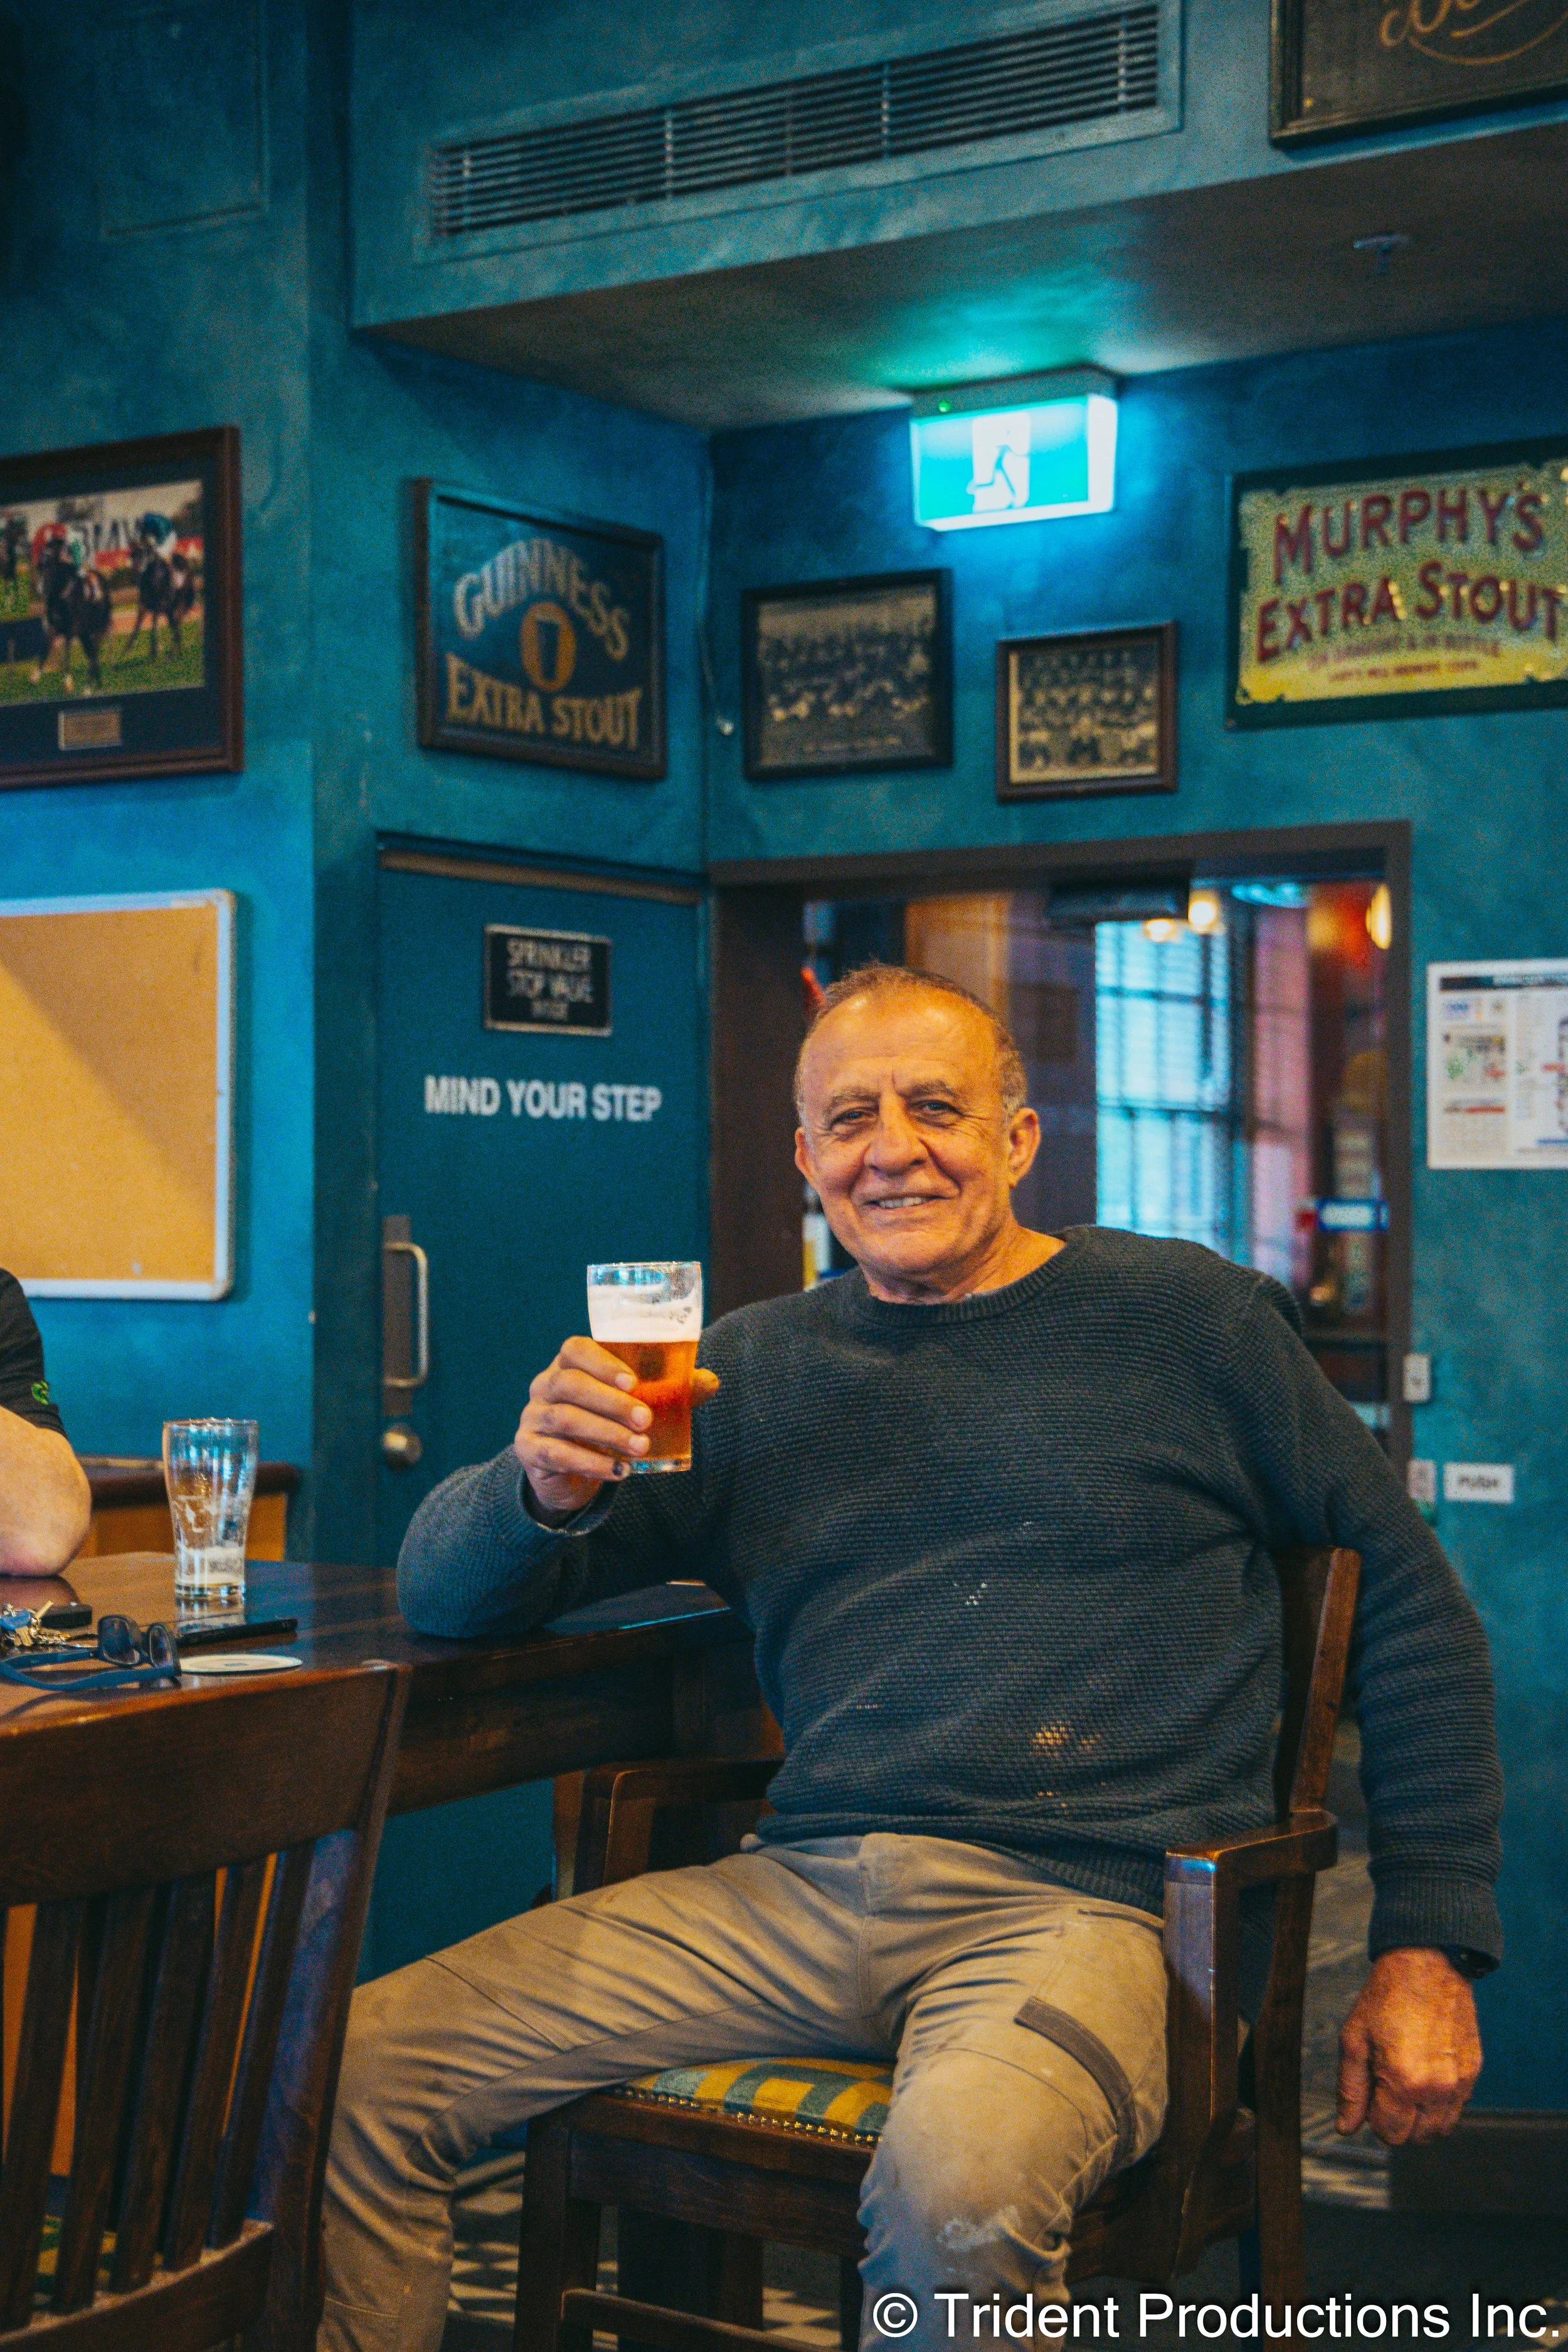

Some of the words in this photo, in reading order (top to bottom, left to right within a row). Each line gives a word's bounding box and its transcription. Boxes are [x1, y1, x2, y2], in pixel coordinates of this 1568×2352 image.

[1273, 480, 1544, 585] MURPHY'S
[453, 538, 629, 661] GUINNESS
[1257, 576, 1407, 664] EXTRA
[1415, 561, 1567, 641] STOUT
[446, 652, 545, 733] EXTRA
[552, 684, 642, 750] STOUT
[425, 1075, 501, 1116] MIND
[506, 1079, 587, 1120] YOUR
[591, 1083, 663, 1121] STEP
